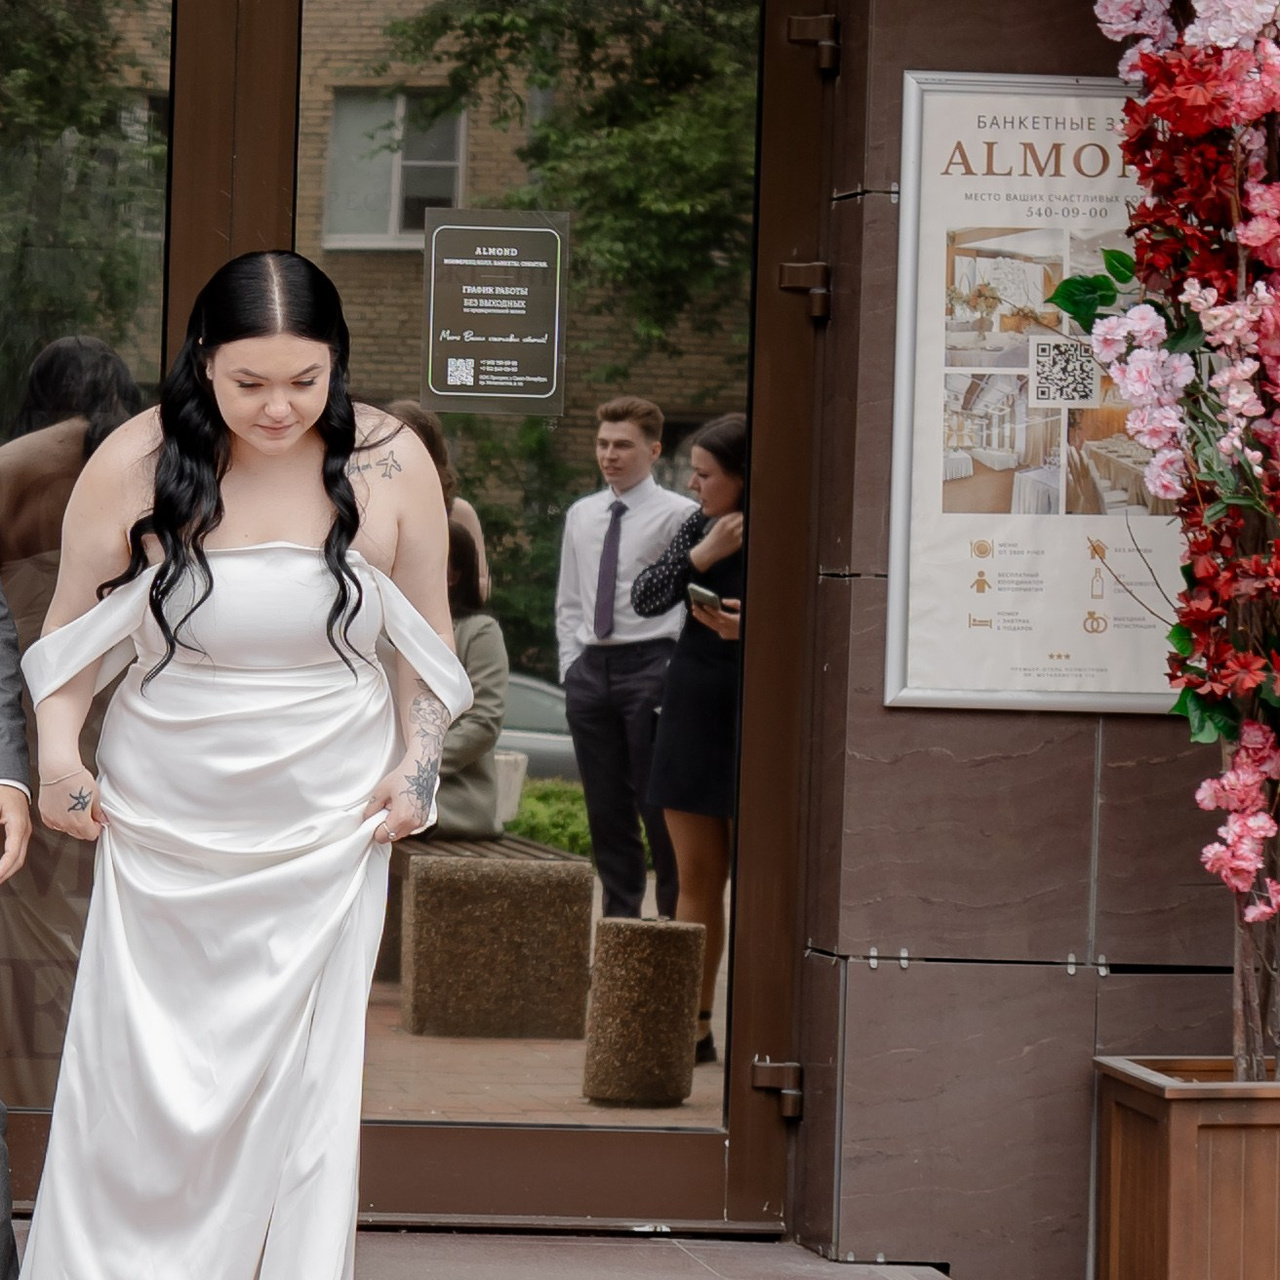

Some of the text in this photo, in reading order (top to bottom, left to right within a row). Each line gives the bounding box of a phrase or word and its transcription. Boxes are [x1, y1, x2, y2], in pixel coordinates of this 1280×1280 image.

[977, 114, 1097, 132] БАНКЕТНЫЕ
[964, 192, 1001, 202] МЕСТО
[1005, 192, 1045, 203] ВАШИХ
[1048, 193, 1120, 204] СЧАСТЛИВЫХ
[1026, 206, 1109, 220] 540-09-00
[474, 246, 519, 257] ALMOND
